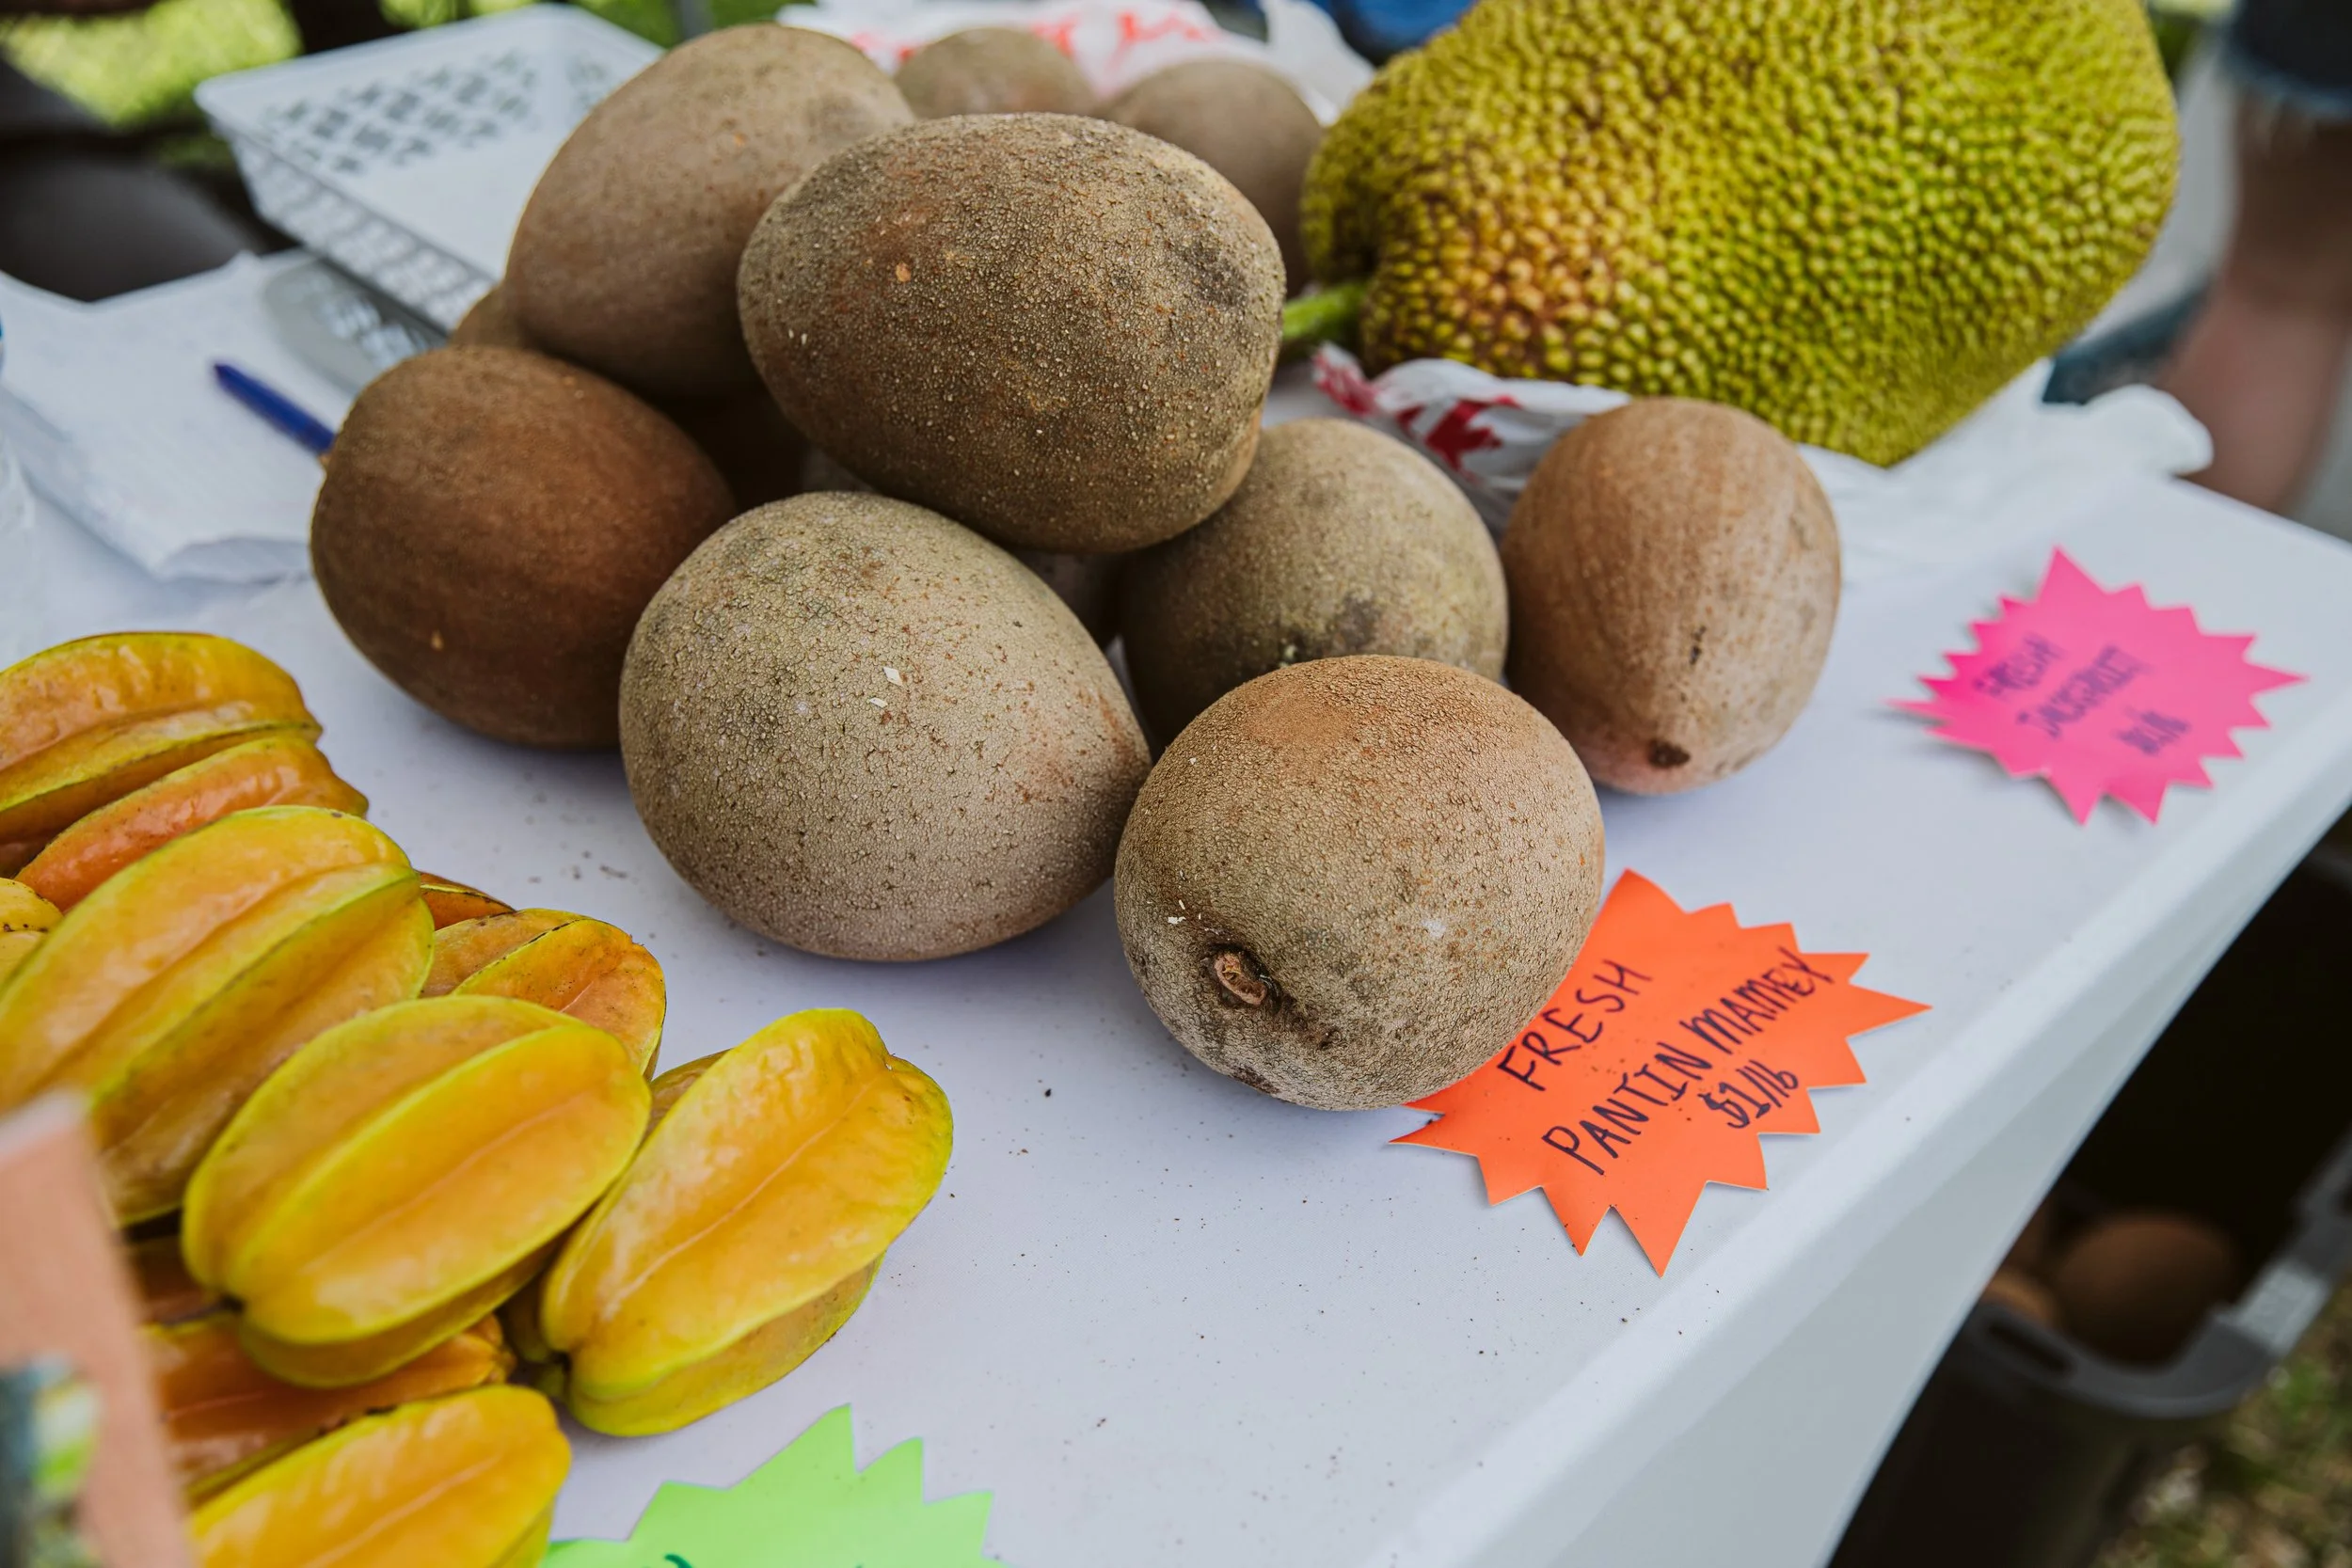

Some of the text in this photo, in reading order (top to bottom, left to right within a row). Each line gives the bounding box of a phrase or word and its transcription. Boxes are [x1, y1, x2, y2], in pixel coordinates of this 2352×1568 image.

[1497, 958, 1654, 1093] FRESH
[1541, 946, 1836, 1176] PANTIN MAMEY
